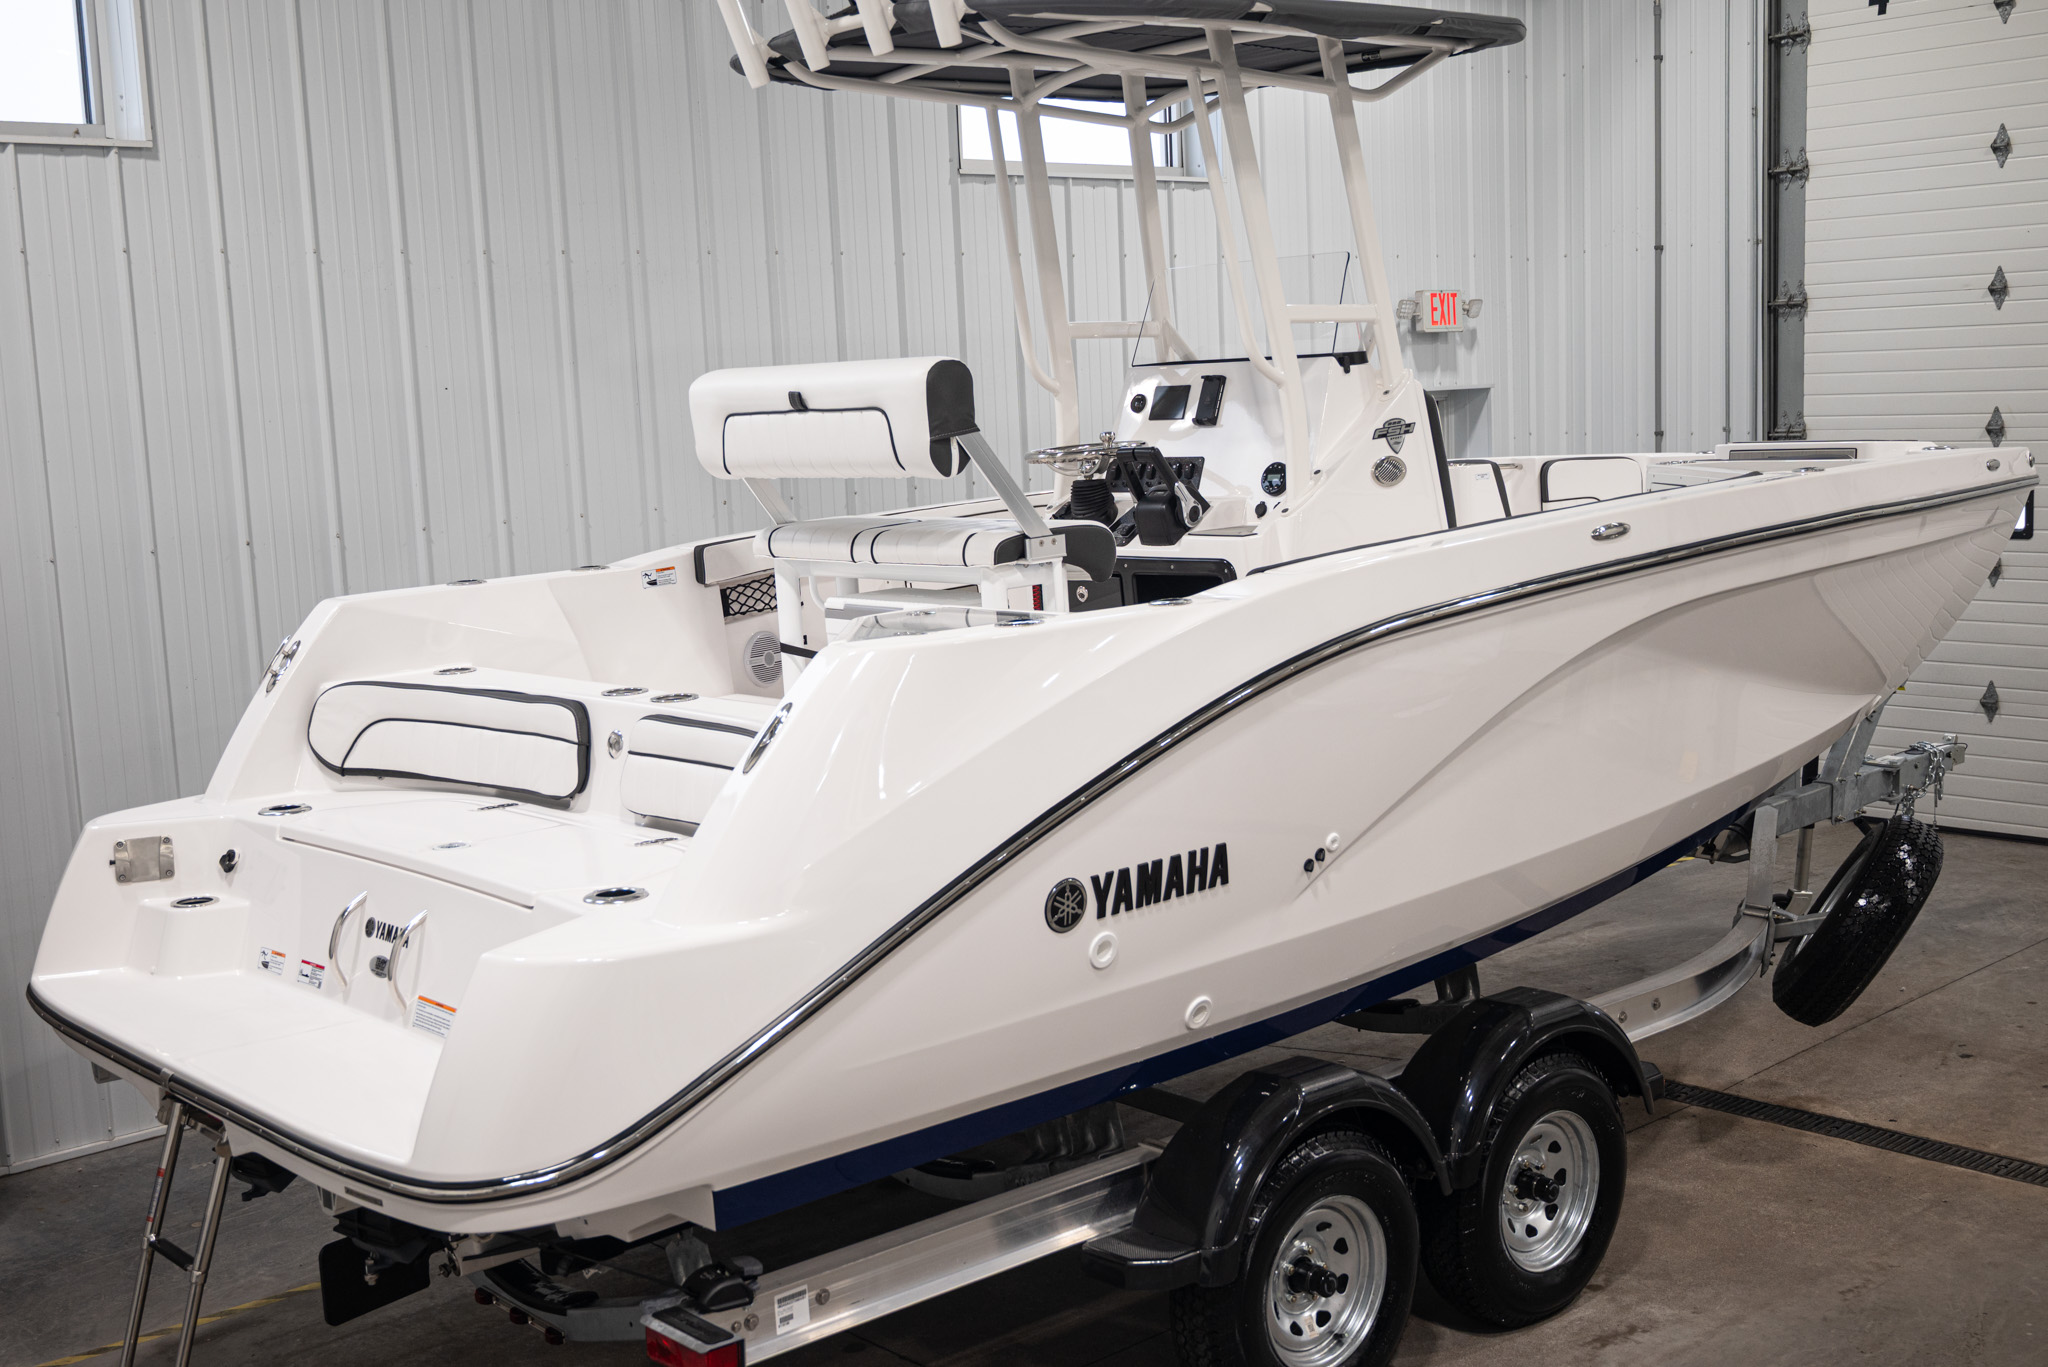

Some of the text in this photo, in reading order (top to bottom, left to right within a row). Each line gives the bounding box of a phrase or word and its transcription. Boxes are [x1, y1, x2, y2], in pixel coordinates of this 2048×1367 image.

[1430, 292, 1457, 326] EXIT
[1372, 422, 1416, 440] FSH
[1090, 842, 1229, 920] YAMAHA
[376, 920, 410, 949] YAMAA
